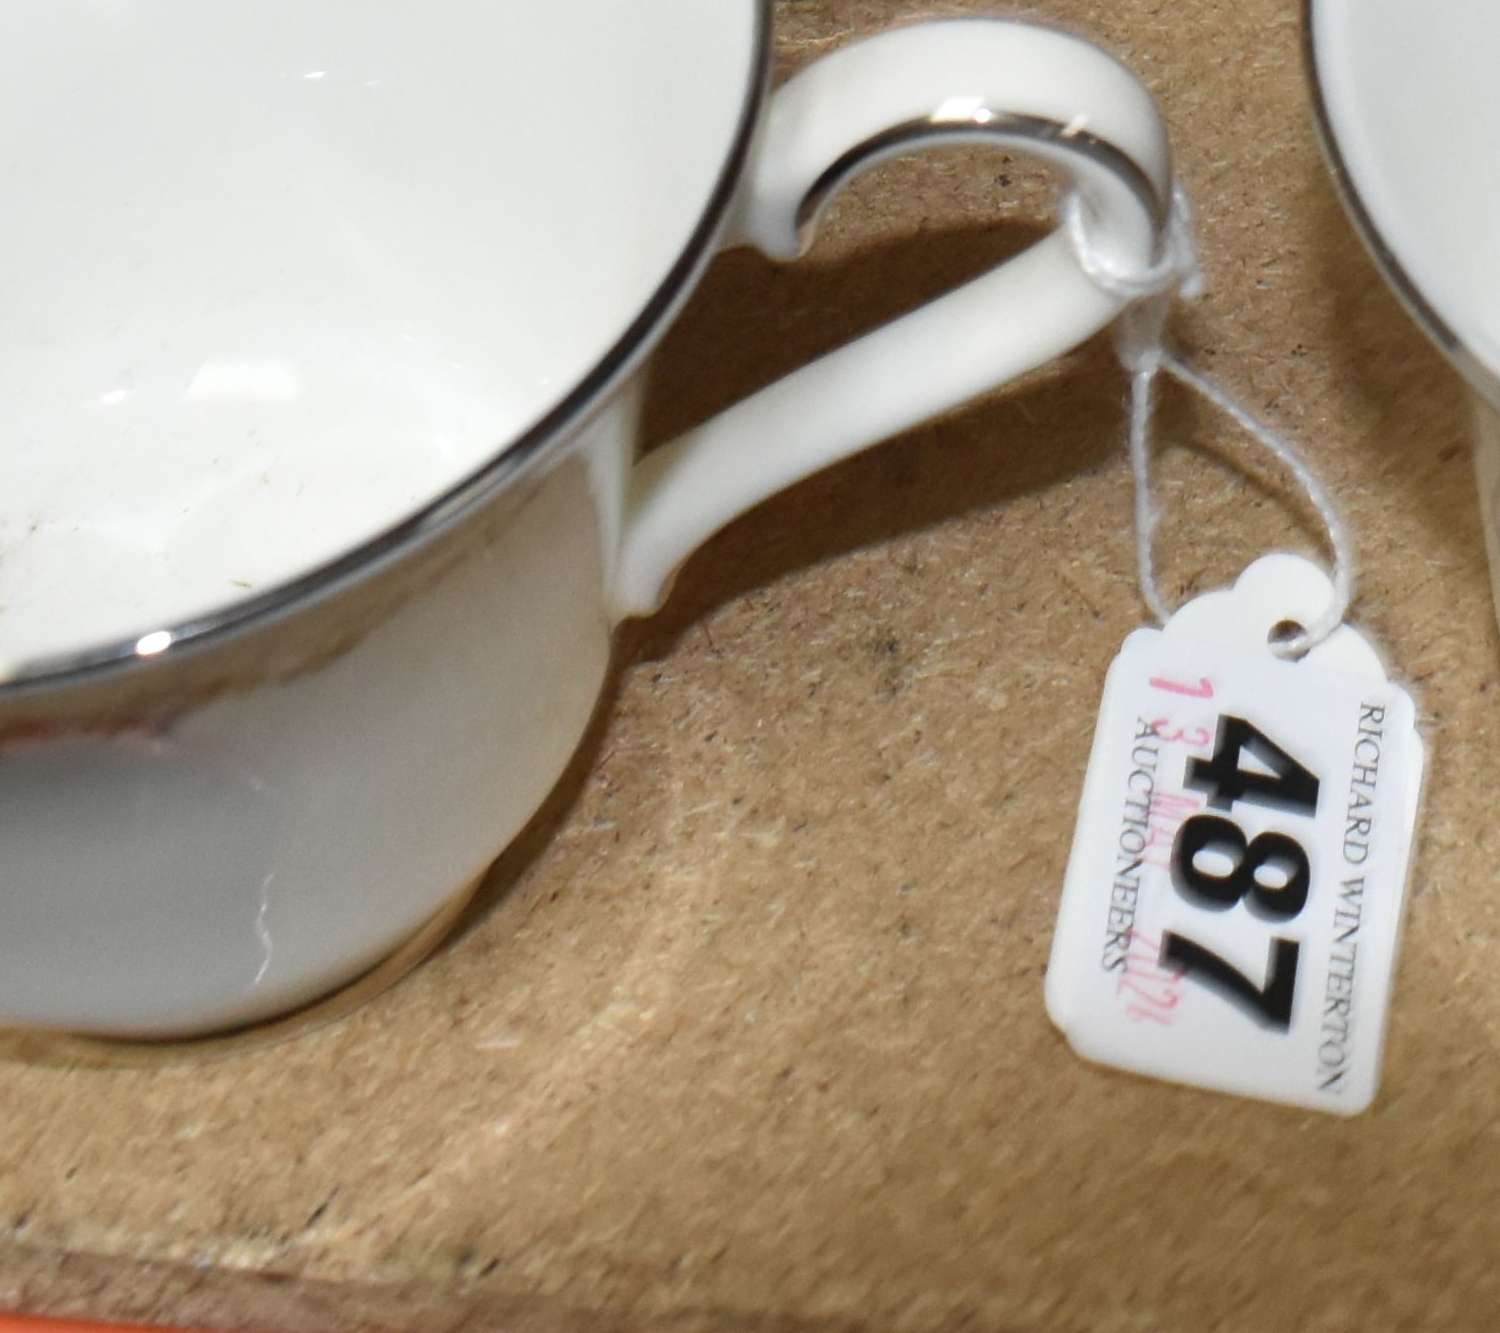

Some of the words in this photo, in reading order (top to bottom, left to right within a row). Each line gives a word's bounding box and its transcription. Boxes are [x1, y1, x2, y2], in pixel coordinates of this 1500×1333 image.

[1101, 715, 1162, 975] AUCTIONEERS
[1161, 712, 1322, 1035] 487
[1344, 701, 1386, 866] RICHARD
[1315, 874, 1367, 1095] WINTERTON
